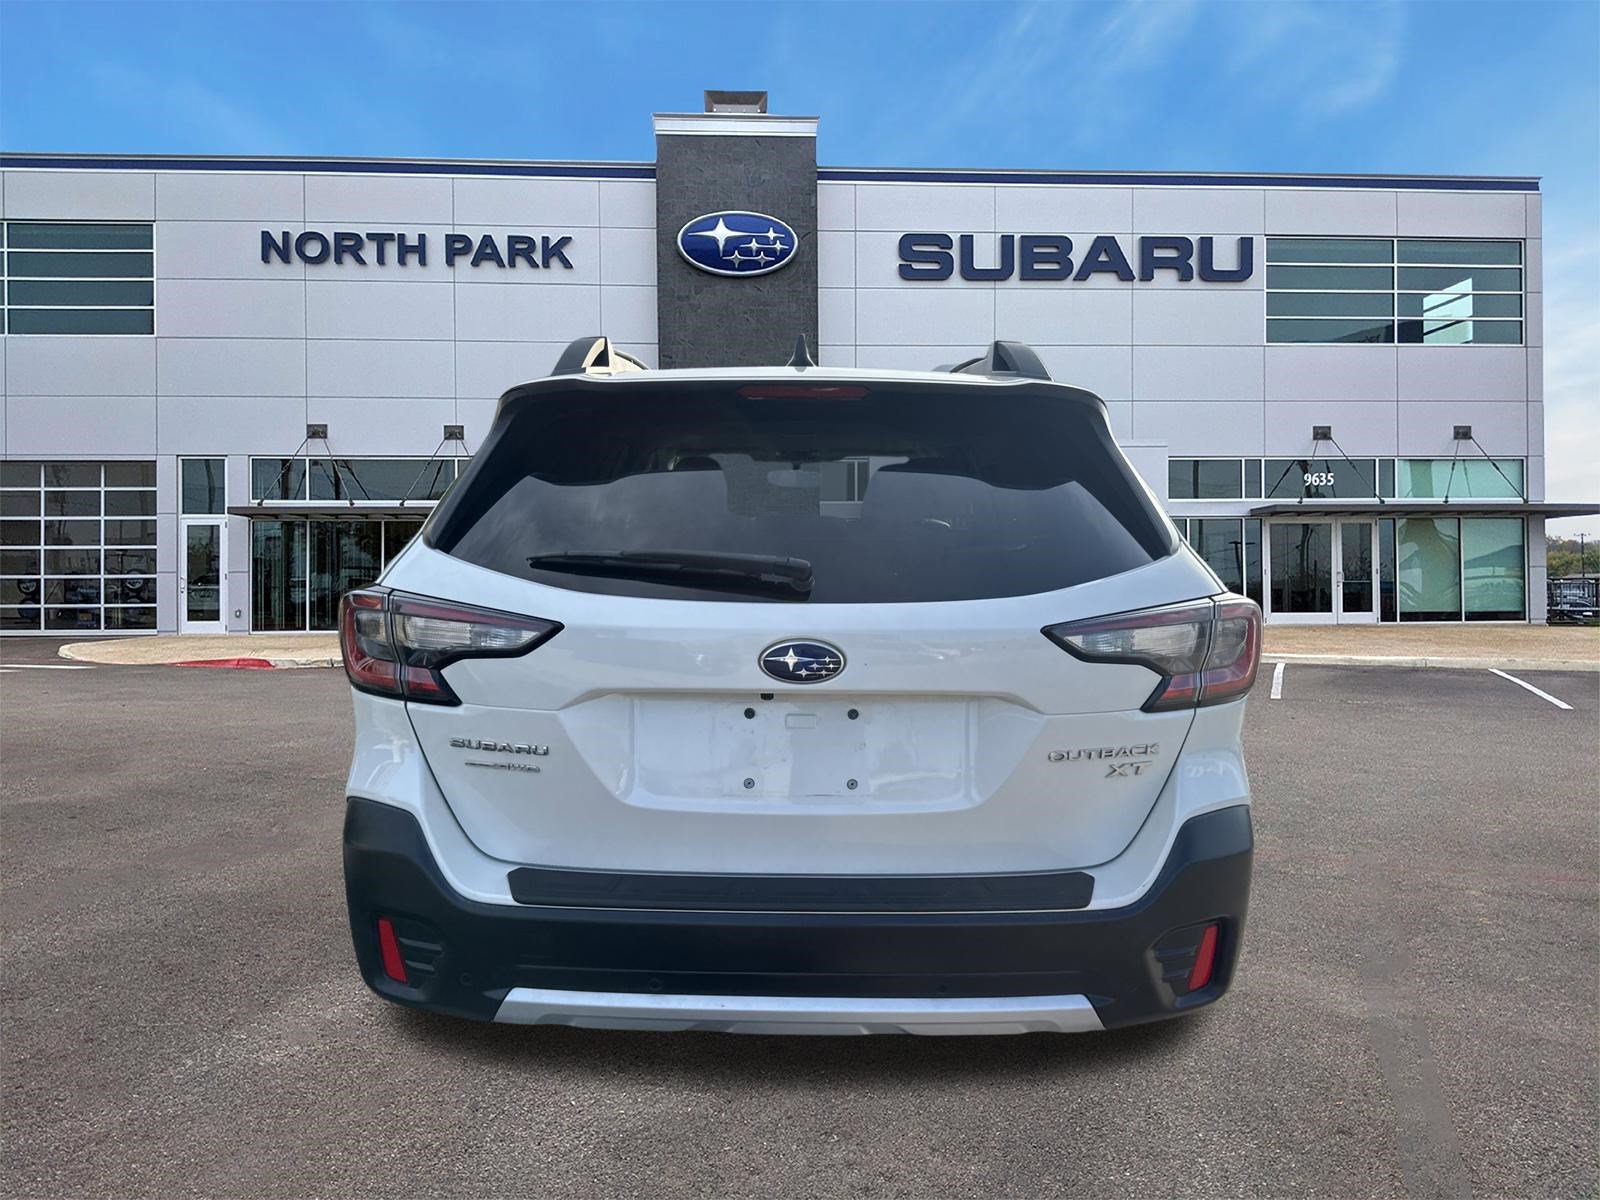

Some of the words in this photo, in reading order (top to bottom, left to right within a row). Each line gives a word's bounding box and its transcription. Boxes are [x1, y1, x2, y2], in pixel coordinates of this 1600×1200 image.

[261, 231, 427, 266] NORTH
[445, 233, 573, 269] PARK
[899, 233, 1254, 282] SUBARU
[1304, 472, 1335, 486] 9635
[449, 737, 549, 756] SUBARU
[1047, 743, 1160, 762] OUTBACK
[1104, 760, 1153, 778] XT
